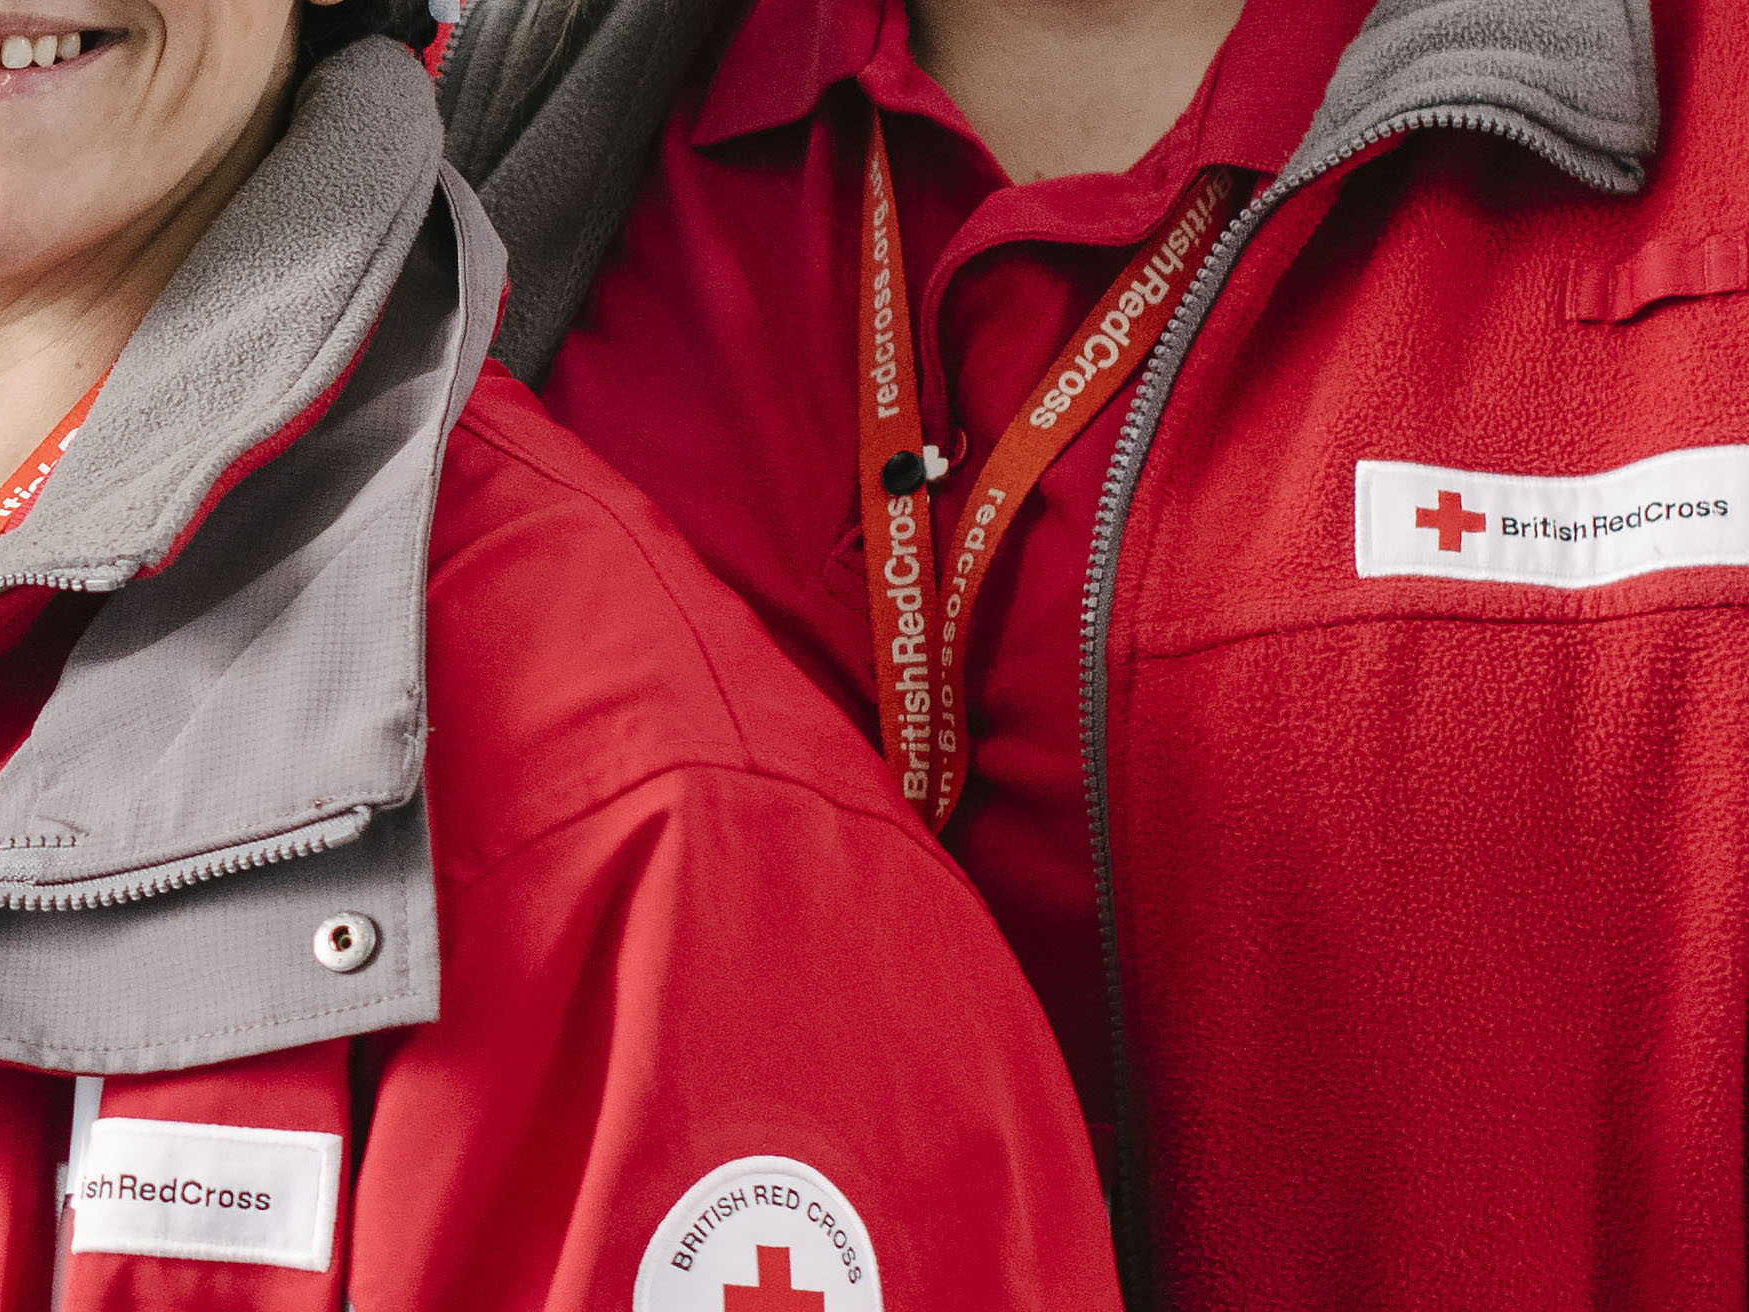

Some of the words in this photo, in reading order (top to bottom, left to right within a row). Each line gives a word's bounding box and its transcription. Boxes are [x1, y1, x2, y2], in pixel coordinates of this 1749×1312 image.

[883, 494, 932, 801] BritishRedCros
[935, 488, 1007, 820] redcross.org.uk
[672, 1188, 750, 1273] BRITISH
[753, 1184, 801, 1212] RED
[806, 1199, 863, 1285] CROSS
